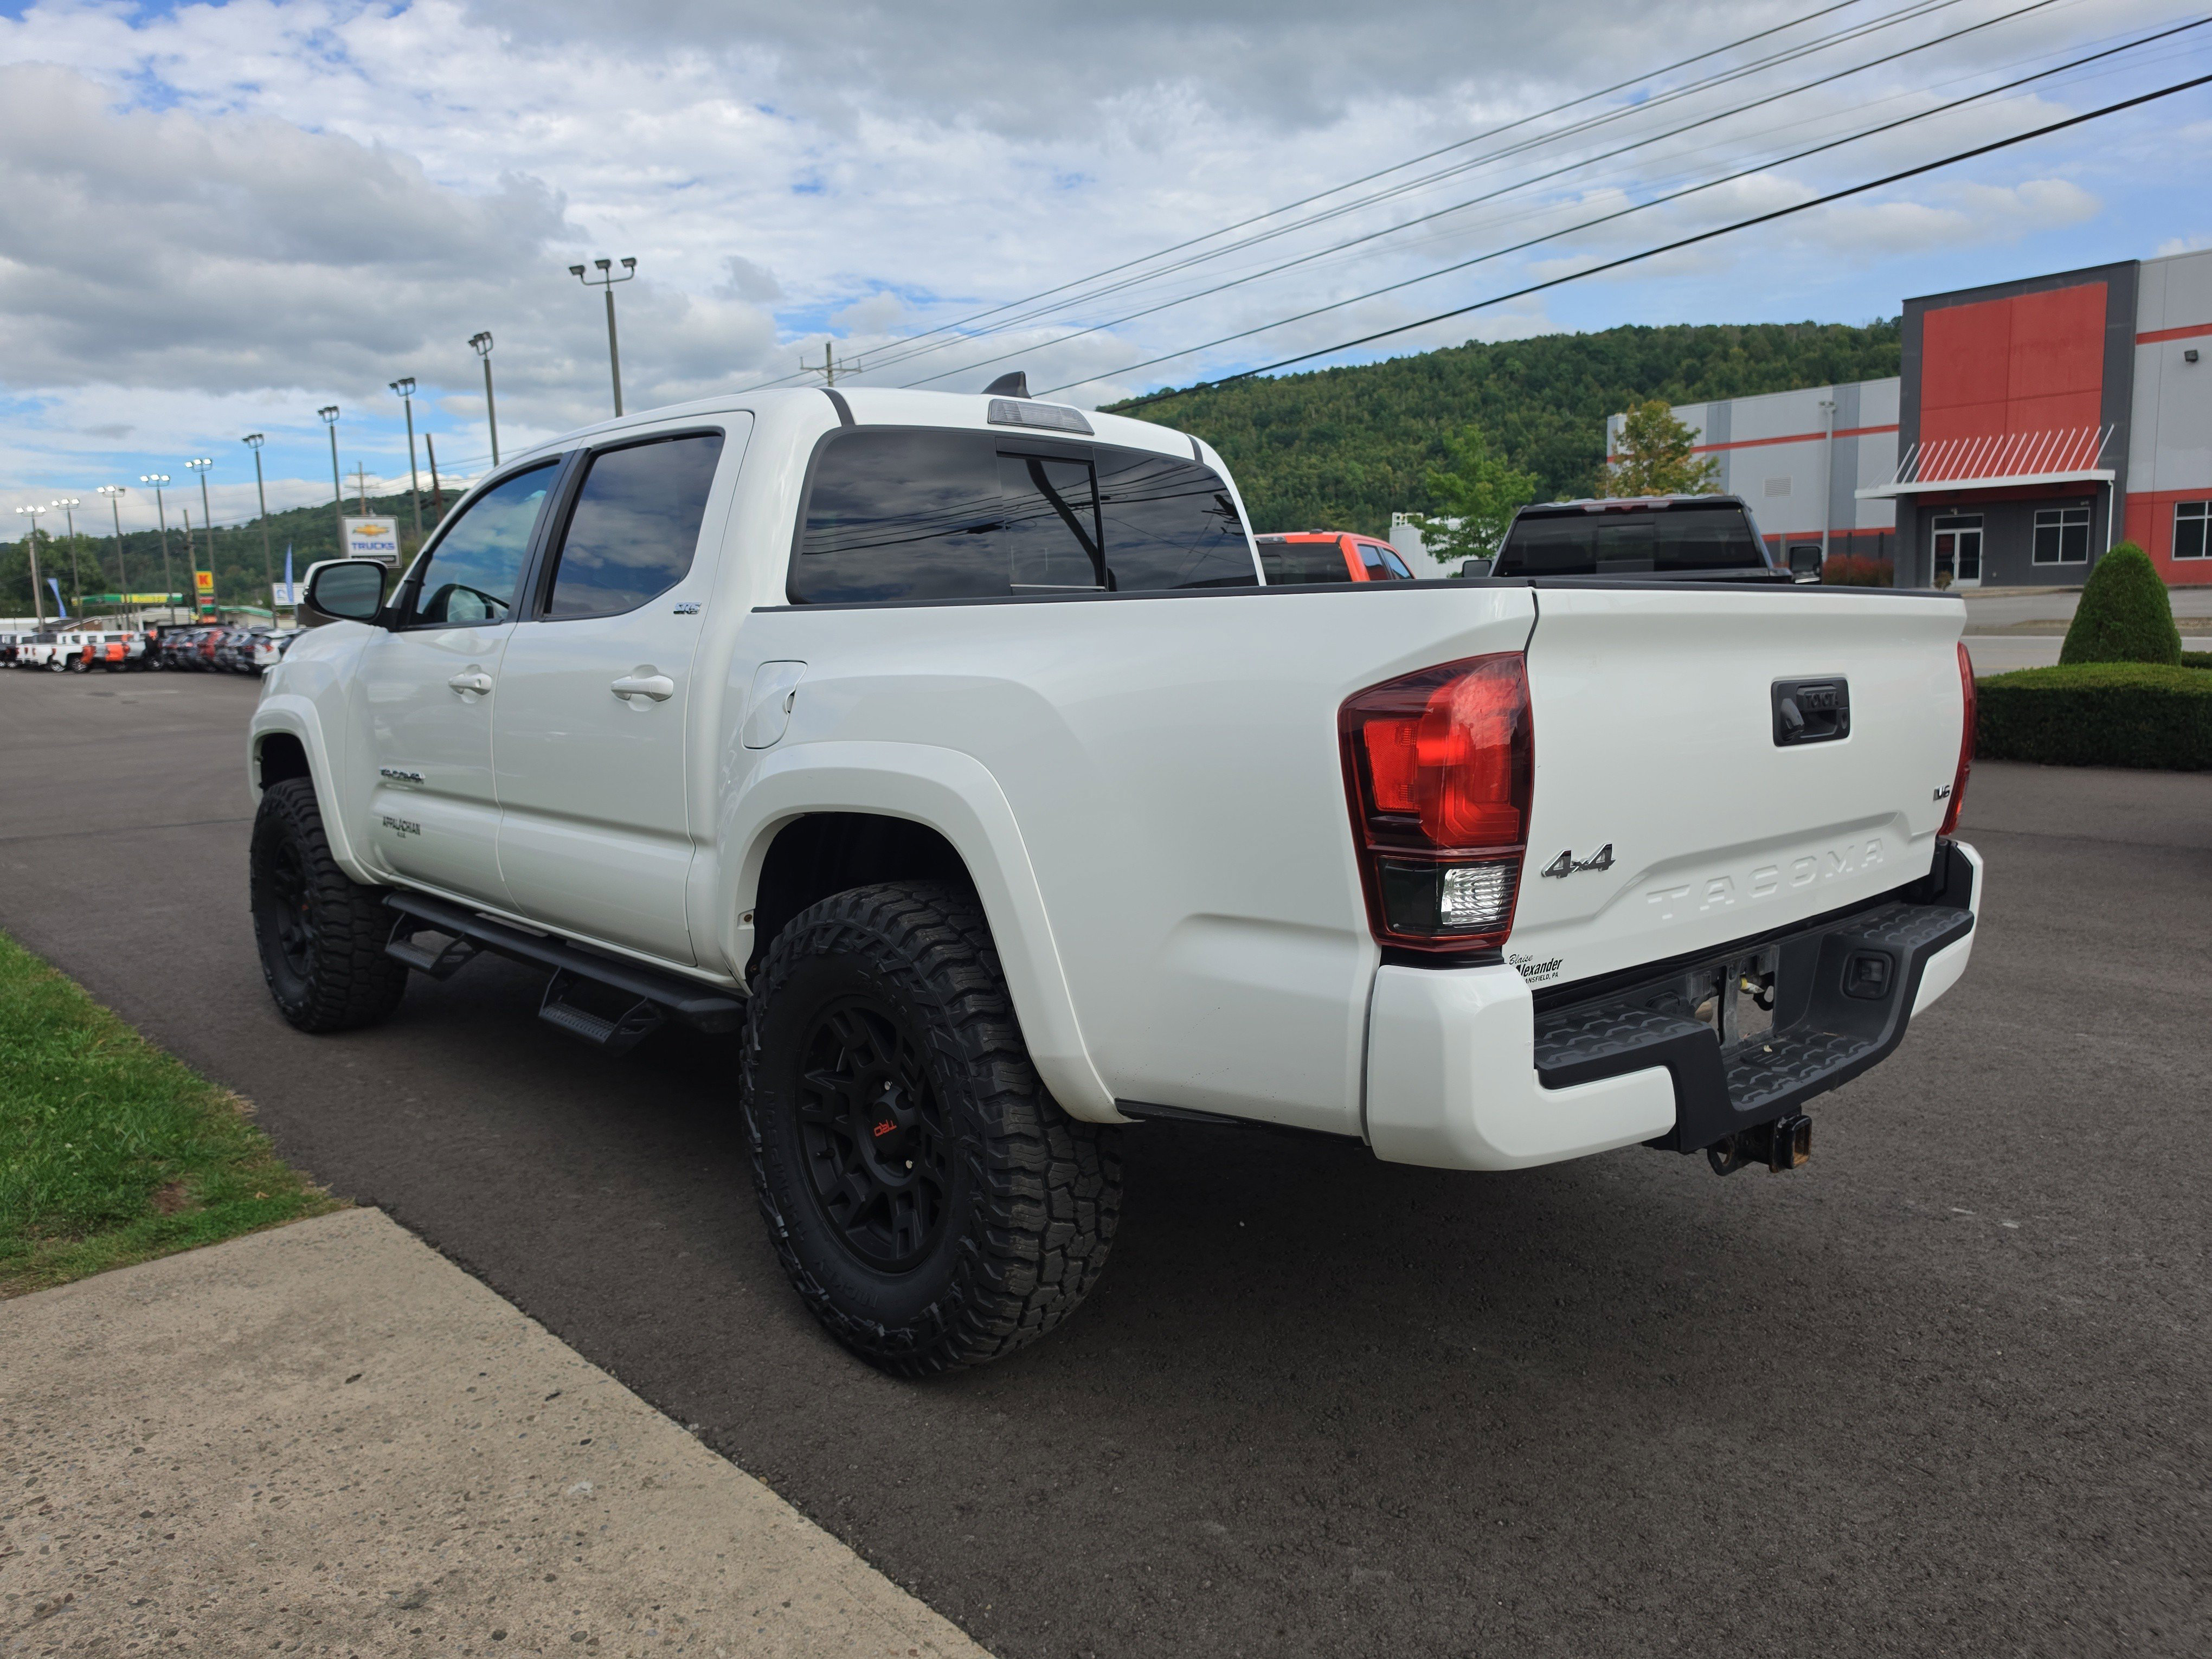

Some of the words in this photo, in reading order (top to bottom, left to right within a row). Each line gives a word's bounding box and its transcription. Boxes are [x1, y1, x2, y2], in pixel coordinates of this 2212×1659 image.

[1646, 838, 1885, 919] TACOMA
[1509, 954, 1533, 964] Blaise
[1526, 974, 1551, 983] ANSFIELD,
[874, 1119, 897, 1137] TRD
